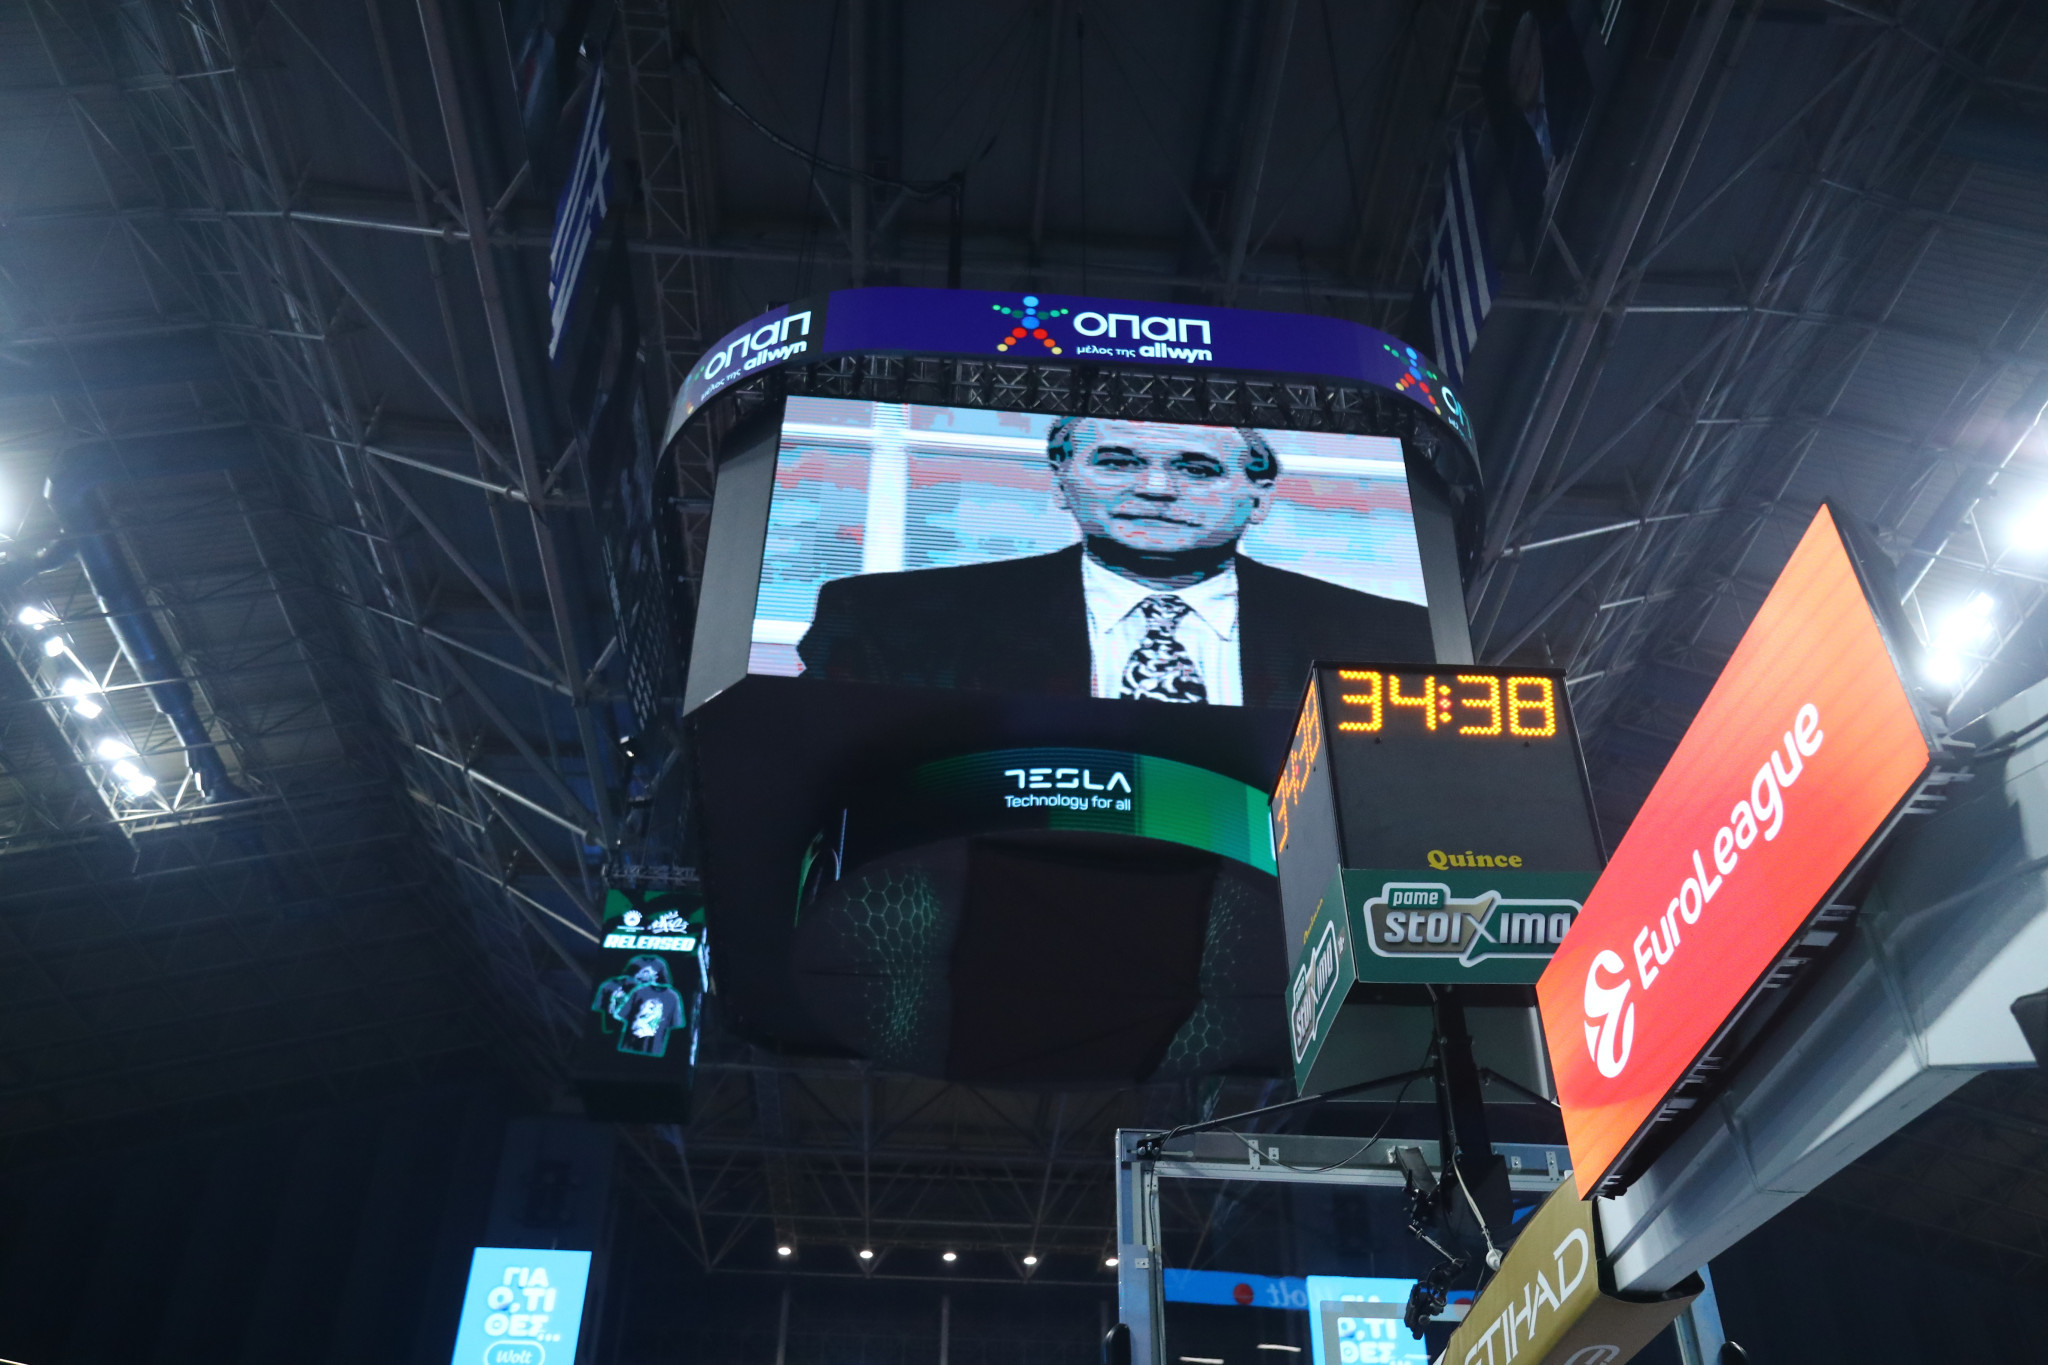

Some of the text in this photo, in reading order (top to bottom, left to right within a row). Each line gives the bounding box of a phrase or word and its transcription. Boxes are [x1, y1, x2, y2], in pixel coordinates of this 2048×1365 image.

[743, 340, 808, 371] allwyn
[1076, 342, 1212, 363] μέλος της allwyn
[1339, 670, 1556, 736] 34:38
[1275, 679, 1320, 853] 34:38
[1004, 768, 1132, 793] TESLA
[1004, 794, 1132, 811] Technology for all
[1633, 703, 1824, 990] EuroLeague
[1427, 850, 1523, 871] Quince
[1392, 890, 1439, 907] pame
[603, 934, 697, 952] RELEASED
[496, 1349, 533, 1364] Wolt
